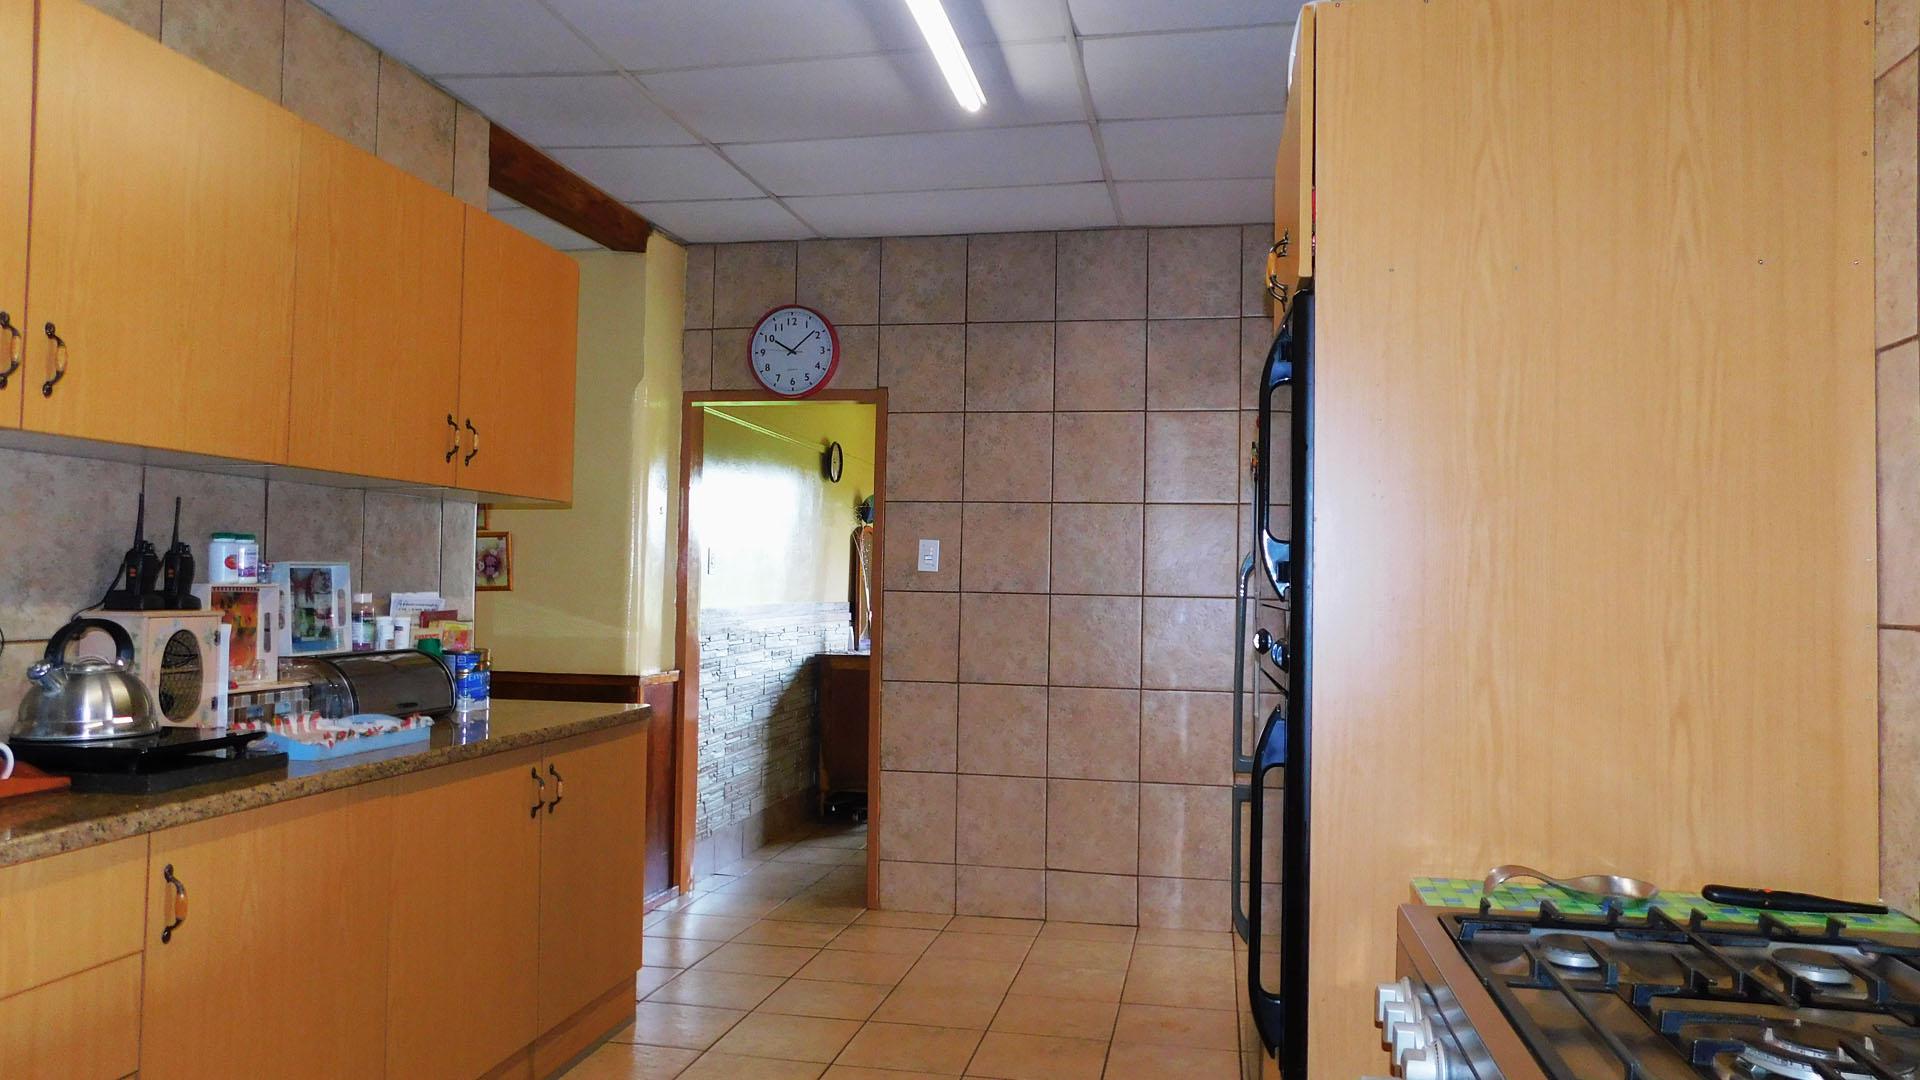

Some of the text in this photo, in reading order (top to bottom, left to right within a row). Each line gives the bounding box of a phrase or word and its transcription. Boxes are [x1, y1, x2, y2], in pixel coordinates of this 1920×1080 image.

[787, 318, 797, 326] 12
[774, 323, 784, 332] 11
[764, 335, 775, 343] 10
[815, 331, 820, 339] 2
[760, 349, 765, 357] 9
[820, 347, 825, 355] 3
[765, 364, 770, 372] 8
[815, 361, 821, 370] 4
[775, 374, 781, 383] 7
[804, 373, 810, 382] 5
[790, 378, 796, 386] 6
